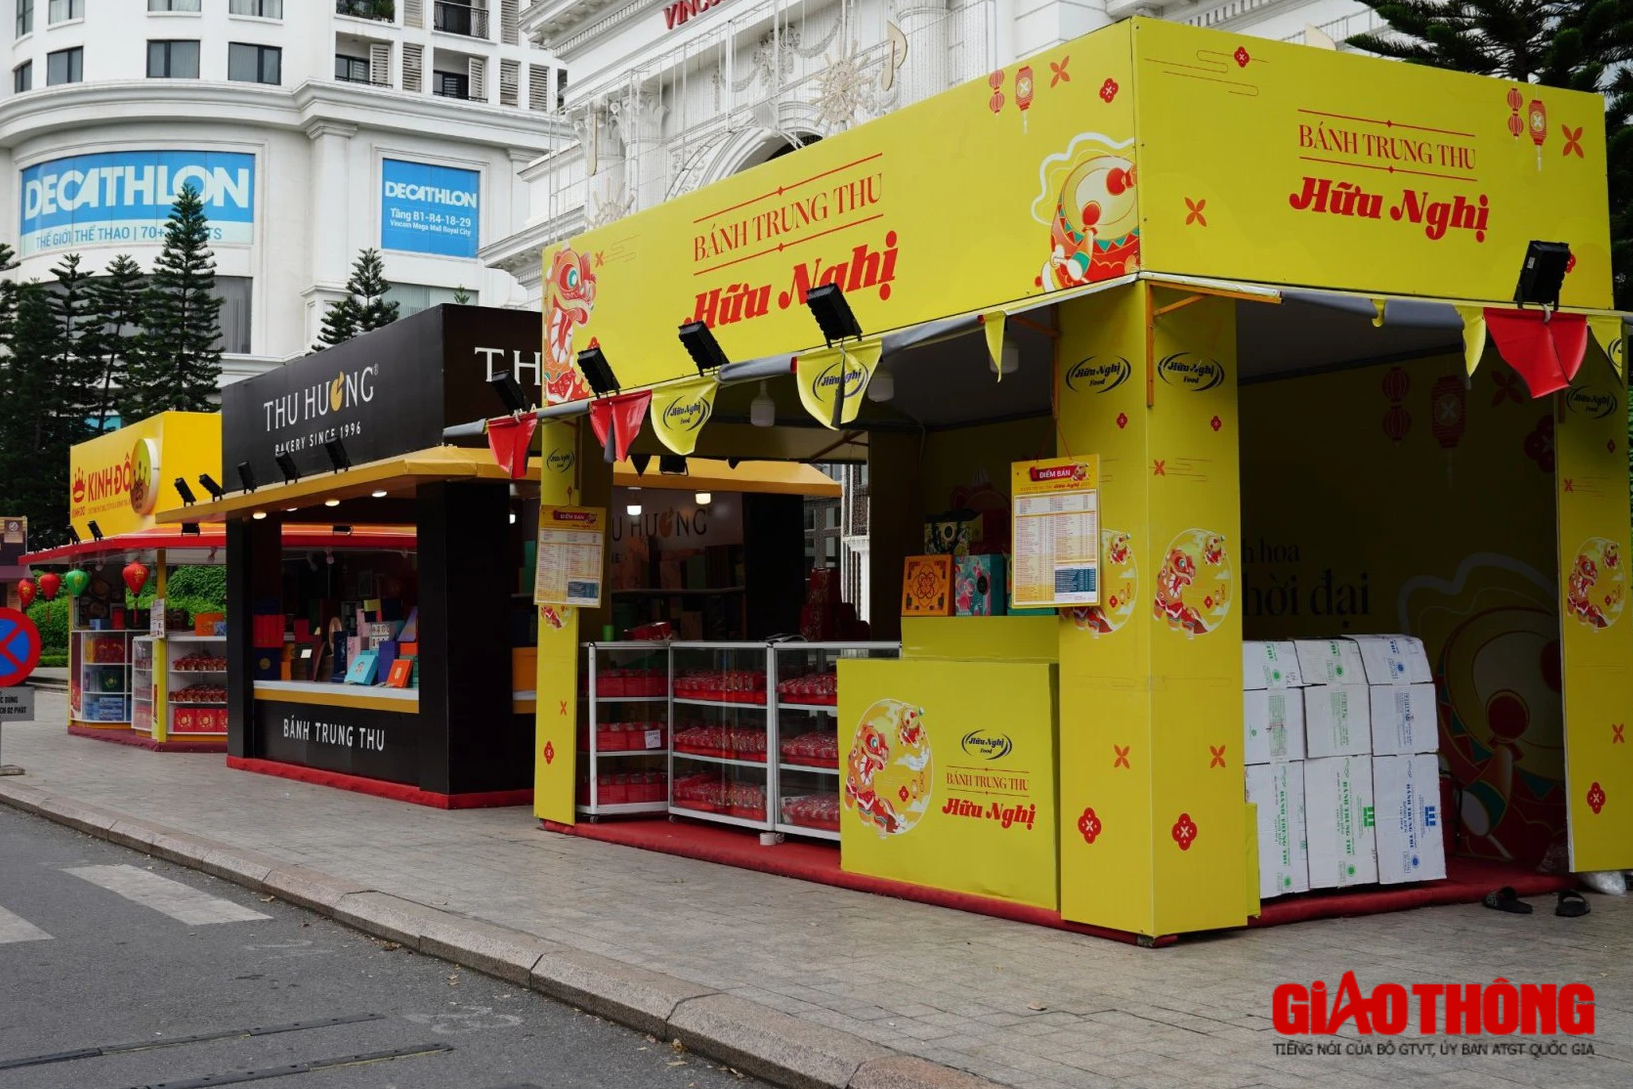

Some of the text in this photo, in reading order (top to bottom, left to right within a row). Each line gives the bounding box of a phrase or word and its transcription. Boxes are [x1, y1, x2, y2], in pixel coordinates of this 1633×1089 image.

[663, 0, 723, 30] VINC
[1299, 121, 1476, 170] BÁNH TRUNG THU
[25, 164, 249, 220] DECATHLON
[385, 181, 477, 208] DECATHLON
[1289, 176, 1490, 243] Hữu Nghị
[98, 227, 130, 240] THAO
[389, 219, 472, 237] Vincom Mega Mall Royal City
[694, 173, 882, 262] BÁNH TRUNG THU
[683, 283, 772, 329] Hữu
[474, 346, 542, 386] TH
[263, 392, 298, 431] THU
[275, 421, 361, 457] BAKERY SINCE 1996
[88, 467, 112, 502] KINH
[114, 451, 131, 495] ĐÔ
[1243, 570, 1300, 617] hời
[283, 714, 385, 751] BÁNH TRUNG THU
[946, 770, 1029, 791] BÁNH TRUNG THU
[942, 797, 1036, 831] Hữu Nghị
